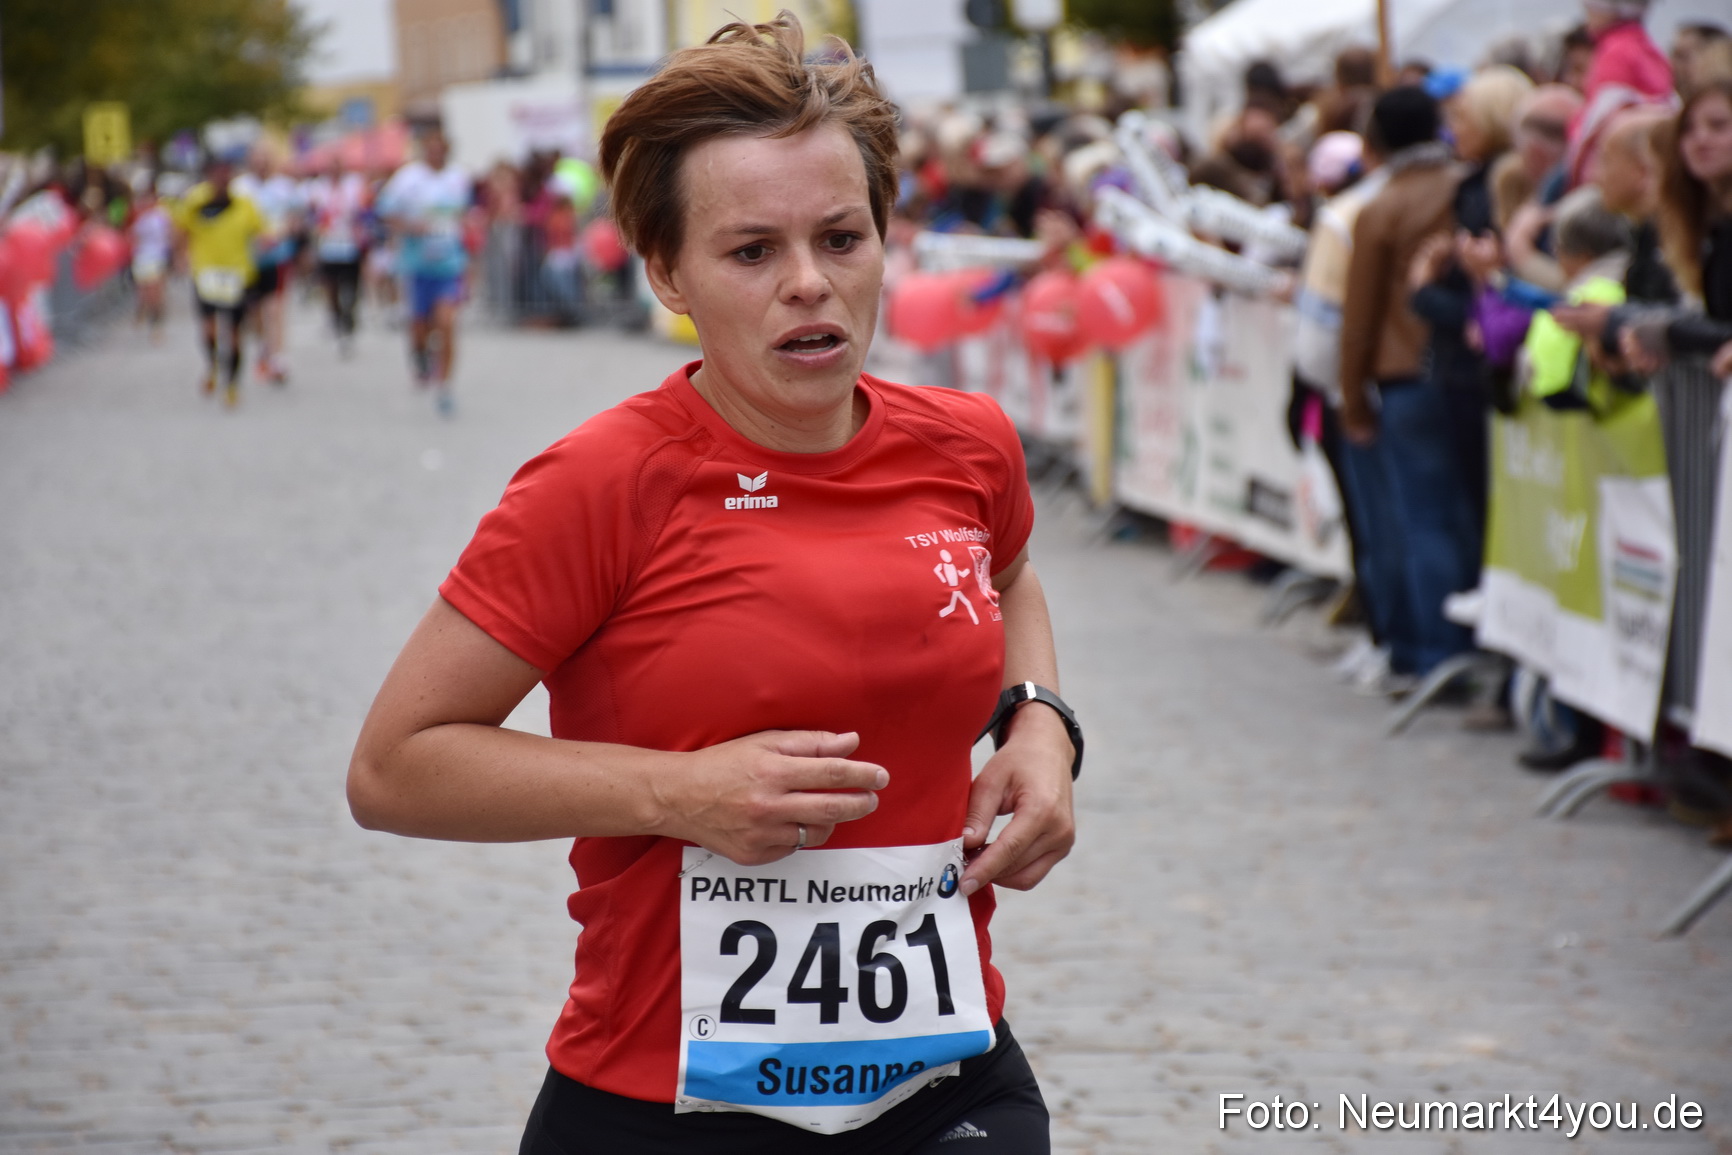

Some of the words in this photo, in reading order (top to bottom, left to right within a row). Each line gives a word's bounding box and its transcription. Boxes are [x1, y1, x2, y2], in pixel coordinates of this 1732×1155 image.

[725, 495, 778, 510] erima
[904, 532, 939, 549] TSV
[691, 876, 797, 903] PARTL
[807, 876, 934, 904] Neumarkt
[720, 913, 955, 1024] 2461
[697, 1018, 709, 1037] C
[757, 1058, 925, 1095] Susanne
